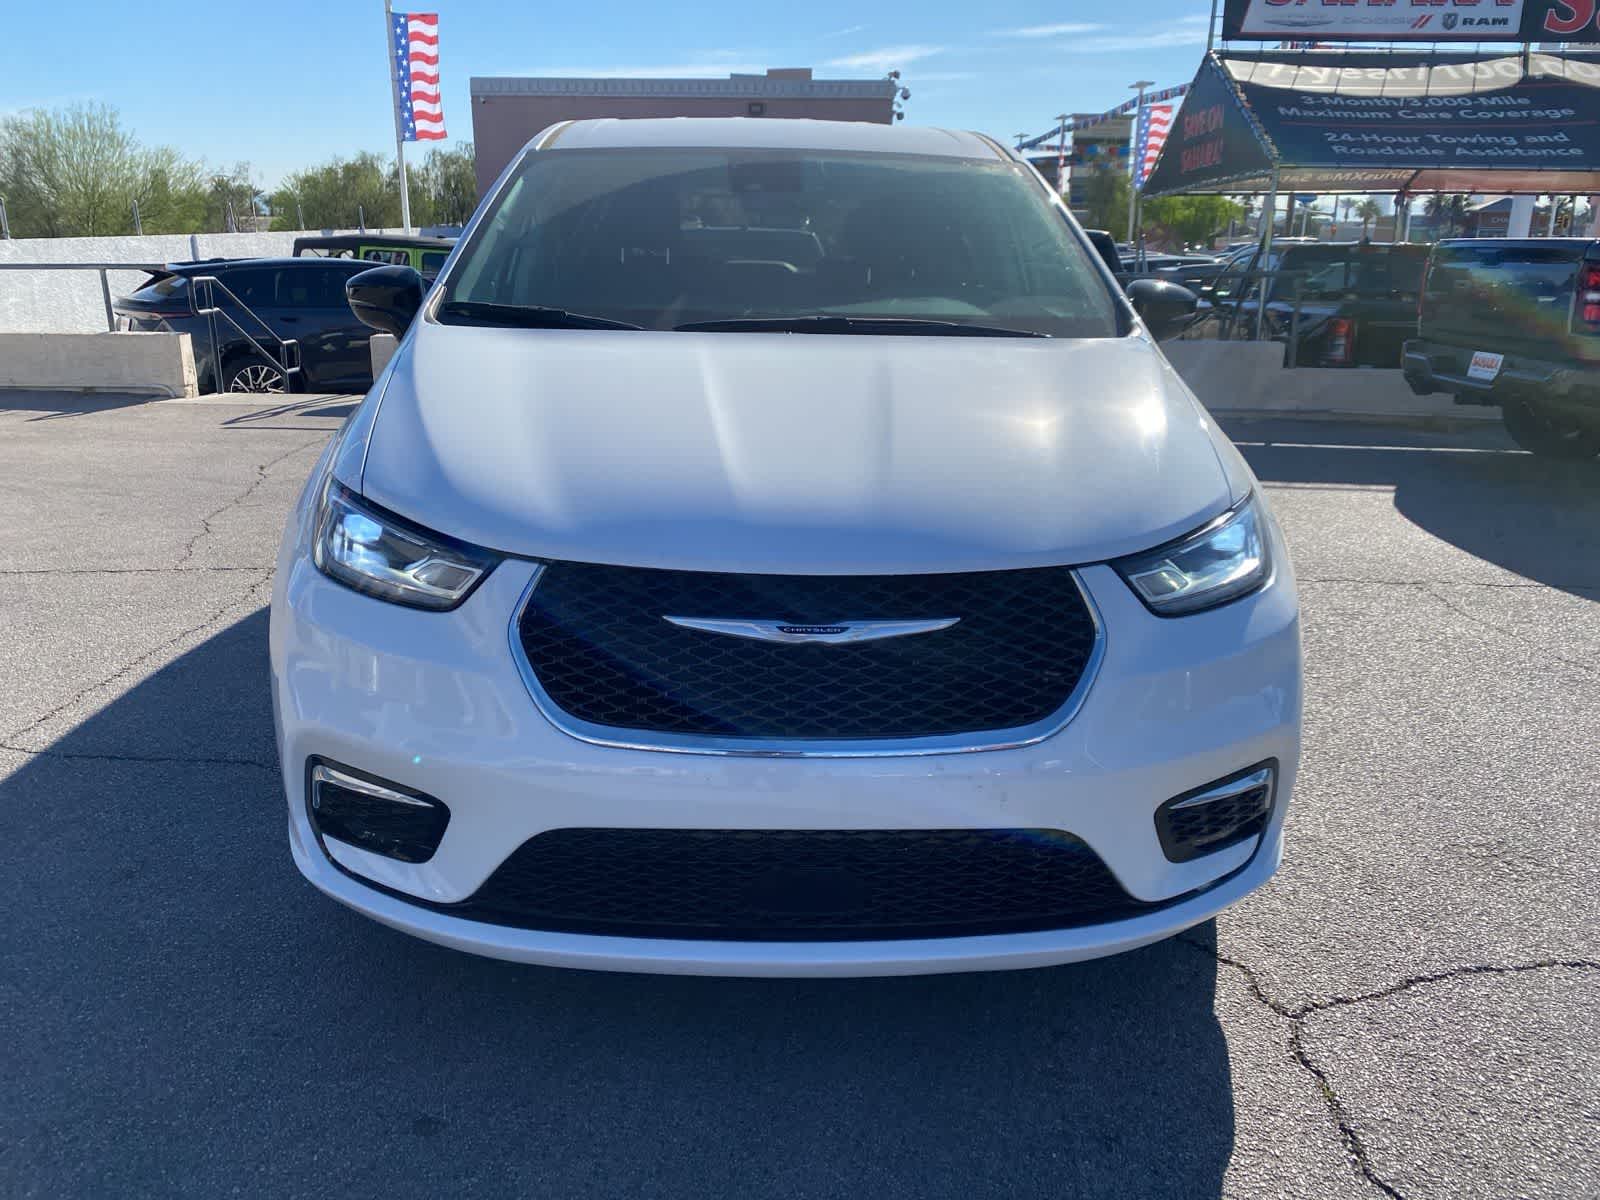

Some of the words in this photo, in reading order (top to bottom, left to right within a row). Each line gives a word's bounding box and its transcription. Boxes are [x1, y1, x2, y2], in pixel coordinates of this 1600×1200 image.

[1462, 17, 1510, 26] RAM
[1278, 106, 1392, 119] Maximum
[1398, 110, 1453, 119] Care
[1458, 108, 1576, 119] Coverage
[1325, 132, 1421, 143] 24-Hour
[1426, 134, 1518, 145] Towing
[1525, 132, 1570, 143] and
[1331, 145, 1447, 156] Roadside
[1455, 147, 1585, 156] Assistance
